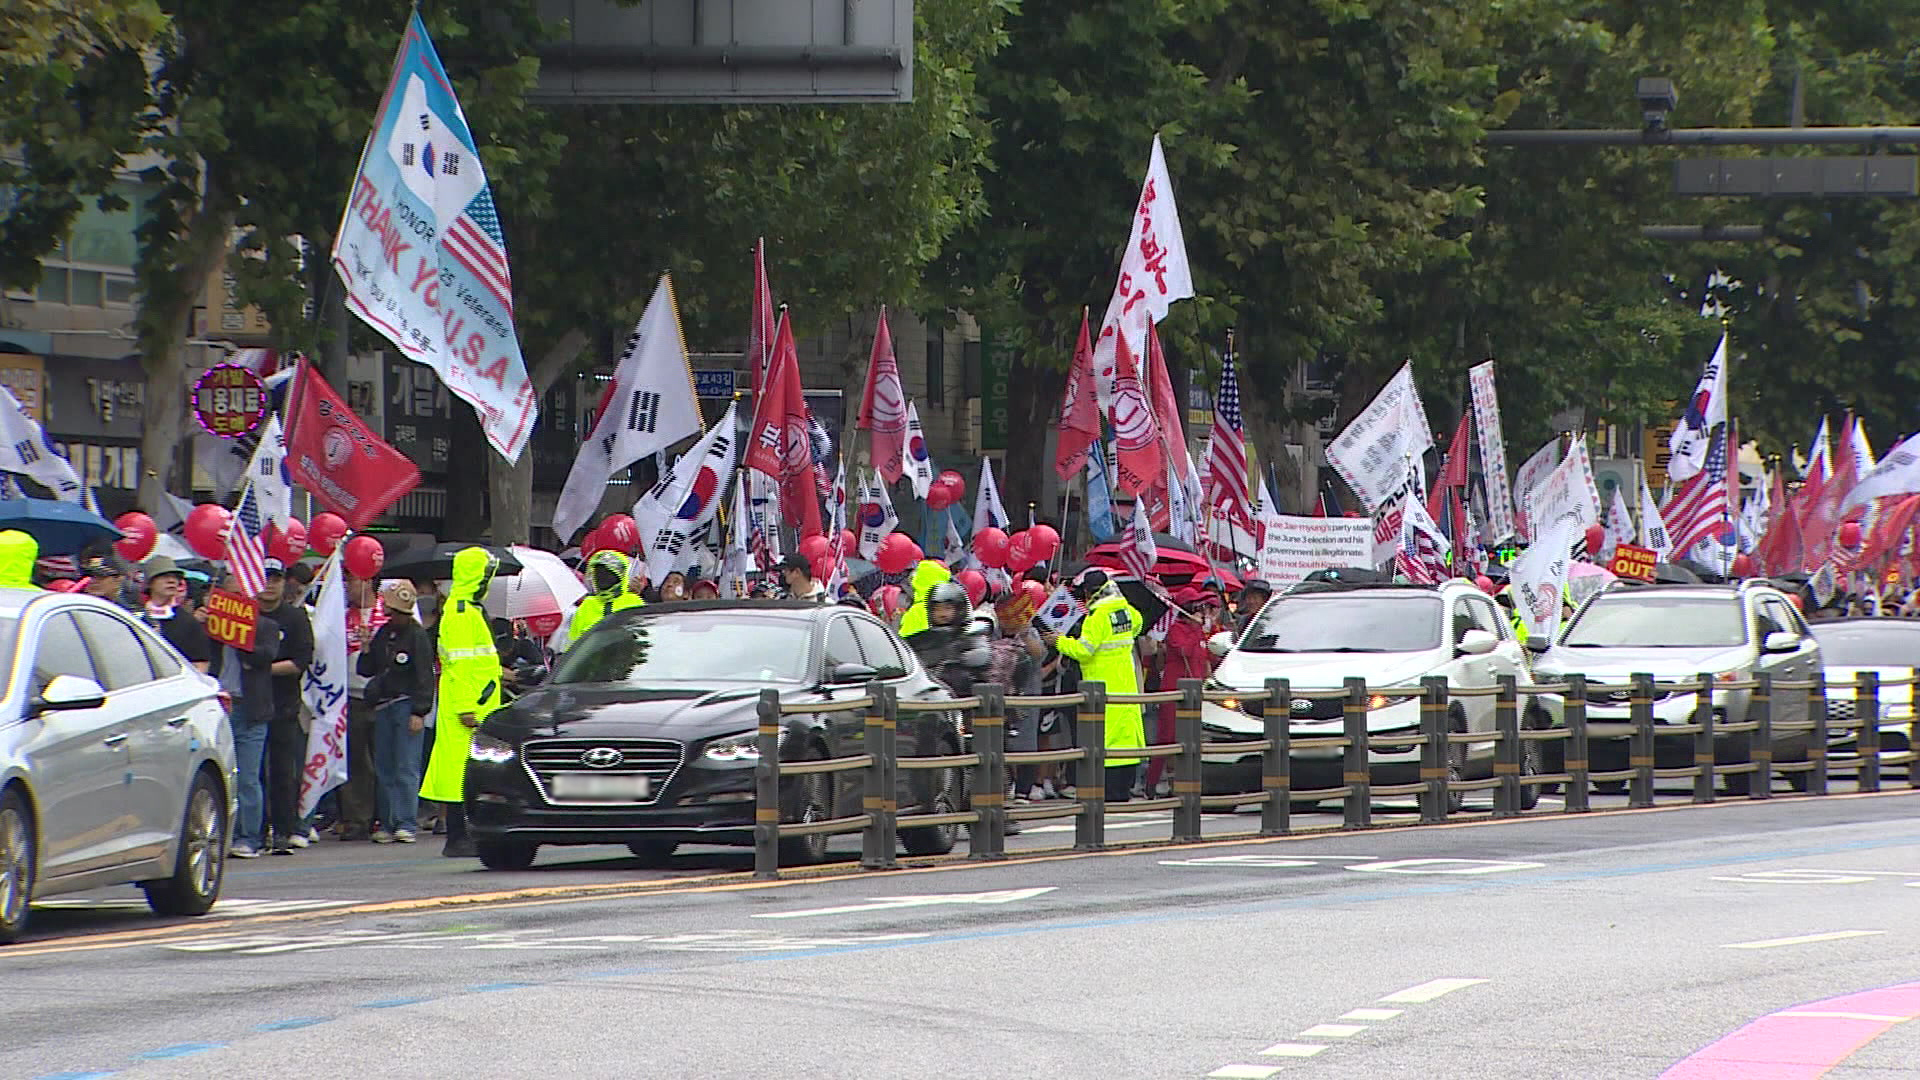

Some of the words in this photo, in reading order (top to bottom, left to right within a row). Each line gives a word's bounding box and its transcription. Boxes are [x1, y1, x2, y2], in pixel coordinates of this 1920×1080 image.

[351, 175, 413, 276] THANK
[1332, 524, 1351, 532] party
[1268, 533, 1281, 541] the
[1281, 534, 1301, 543] June
[1308, 536, 1336, 544] election
[1337, 536, 1352, 544] and
[1352, 536, 1364, 544] his
[1266, 547, 1313, 557] government
[1266, 558, 1276, 567] He
[1284, 560, 1297, 568] not
[1298, 560, 1319, 568] South
[1615, 559, 1654, 577] OUT
[208, 593, 255, 620] CHINA
[207, 614, 253, 645] OUT
